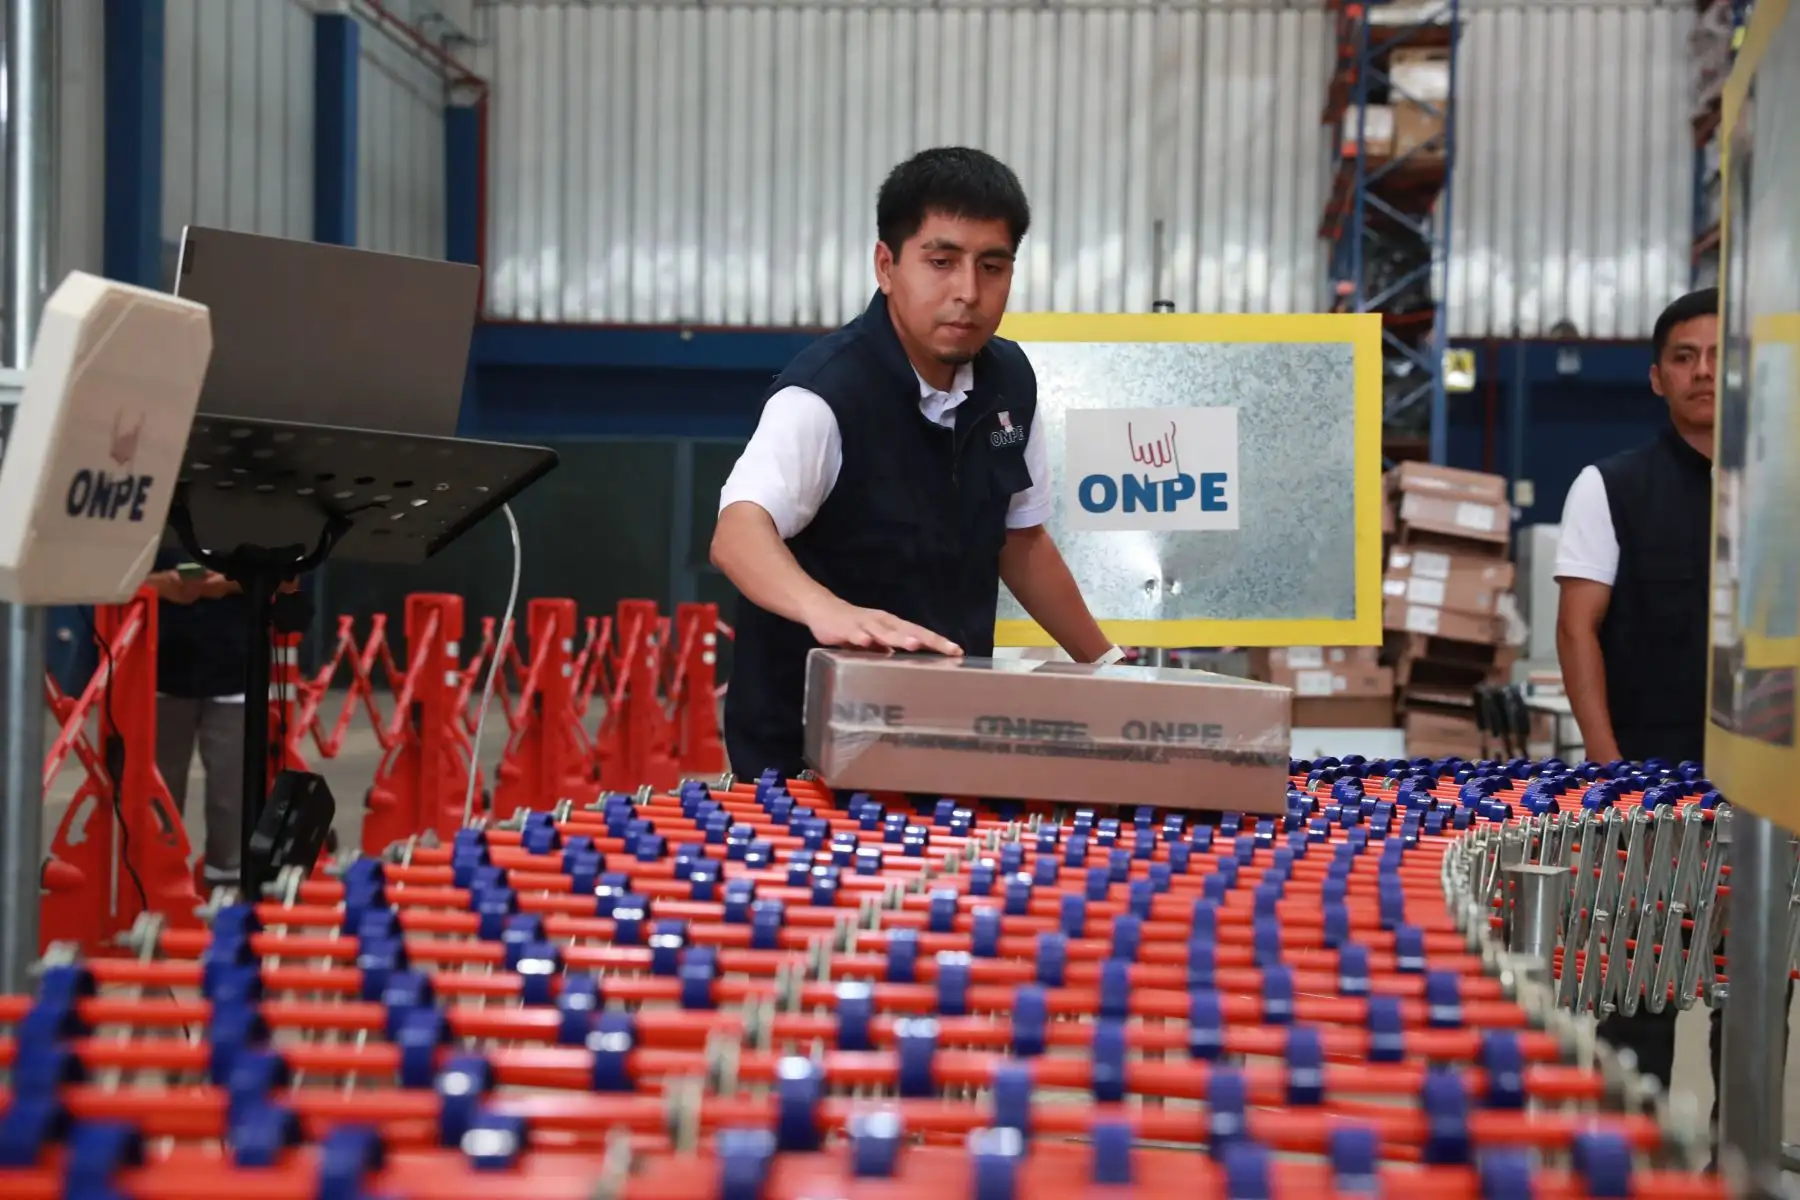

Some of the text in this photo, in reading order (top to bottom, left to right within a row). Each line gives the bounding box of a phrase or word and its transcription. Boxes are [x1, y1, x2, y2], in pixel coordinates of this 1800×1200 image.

[991, 425, 1023, 447] ONPE
[66, 469, 154, 522] ONPE
[1078, 473, 1228, 513] ONPE
[1121, 720, 1223, 743] ONPE
